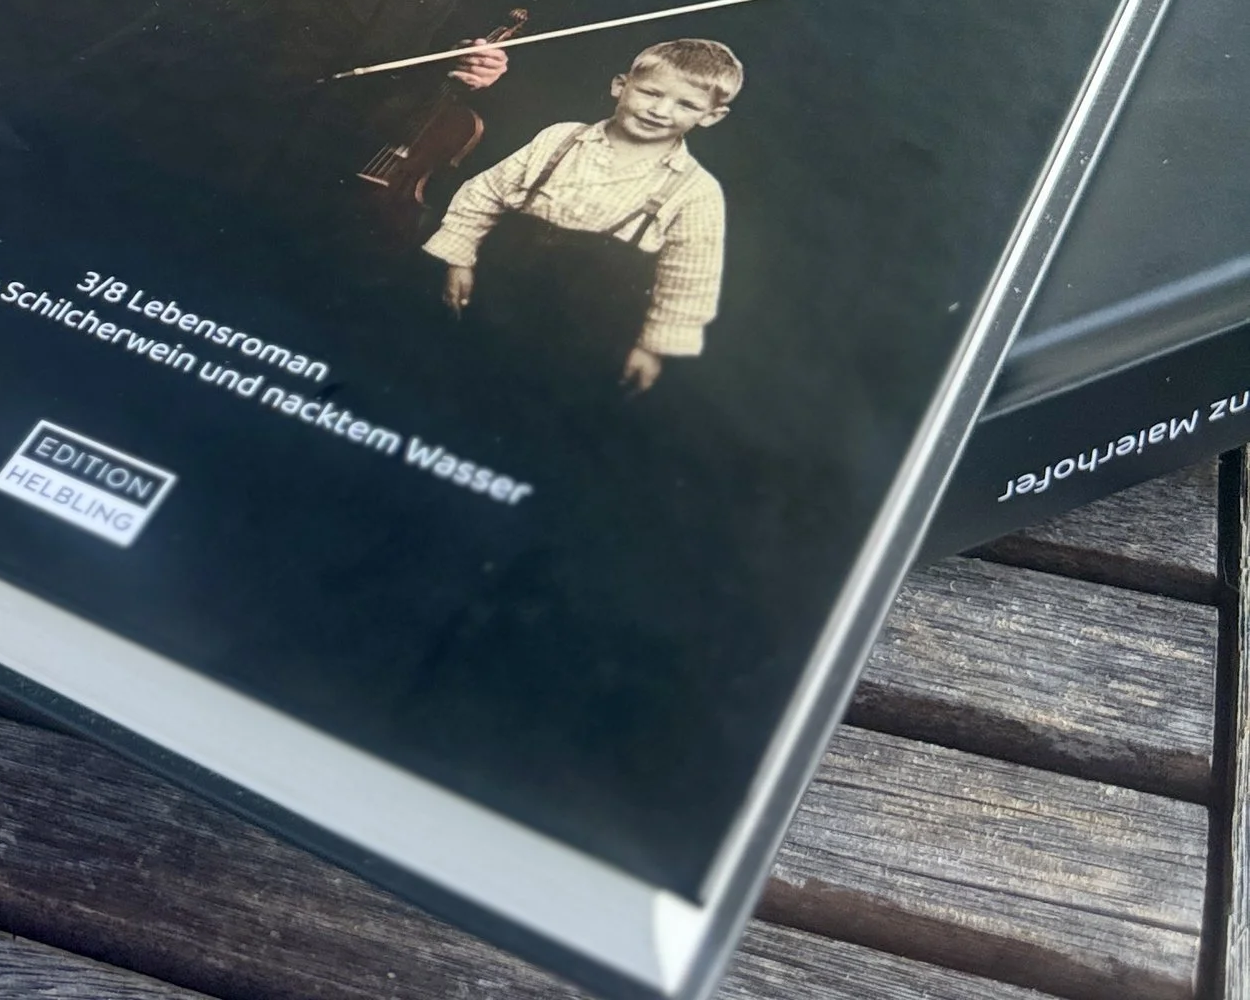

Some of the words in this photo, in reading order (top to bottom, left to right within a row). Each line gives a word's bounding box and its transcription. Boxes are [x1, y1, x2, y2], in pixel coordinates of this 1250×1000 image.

[75, 270, 128, 304] 3/8
[126, 288, 330, 383] Lebensroman
[0, 280, 196, 373] Schilcherwein
[198, 360, 264, 399] und
[260, 386, 401, 456] nacktem
[404, 435, 534, 506] Wasser
[5, 464, 135, 532] HELBLING
[34, 435, 154, 499] EDITION
[996, 407, 1200, 503] Maierhofer
